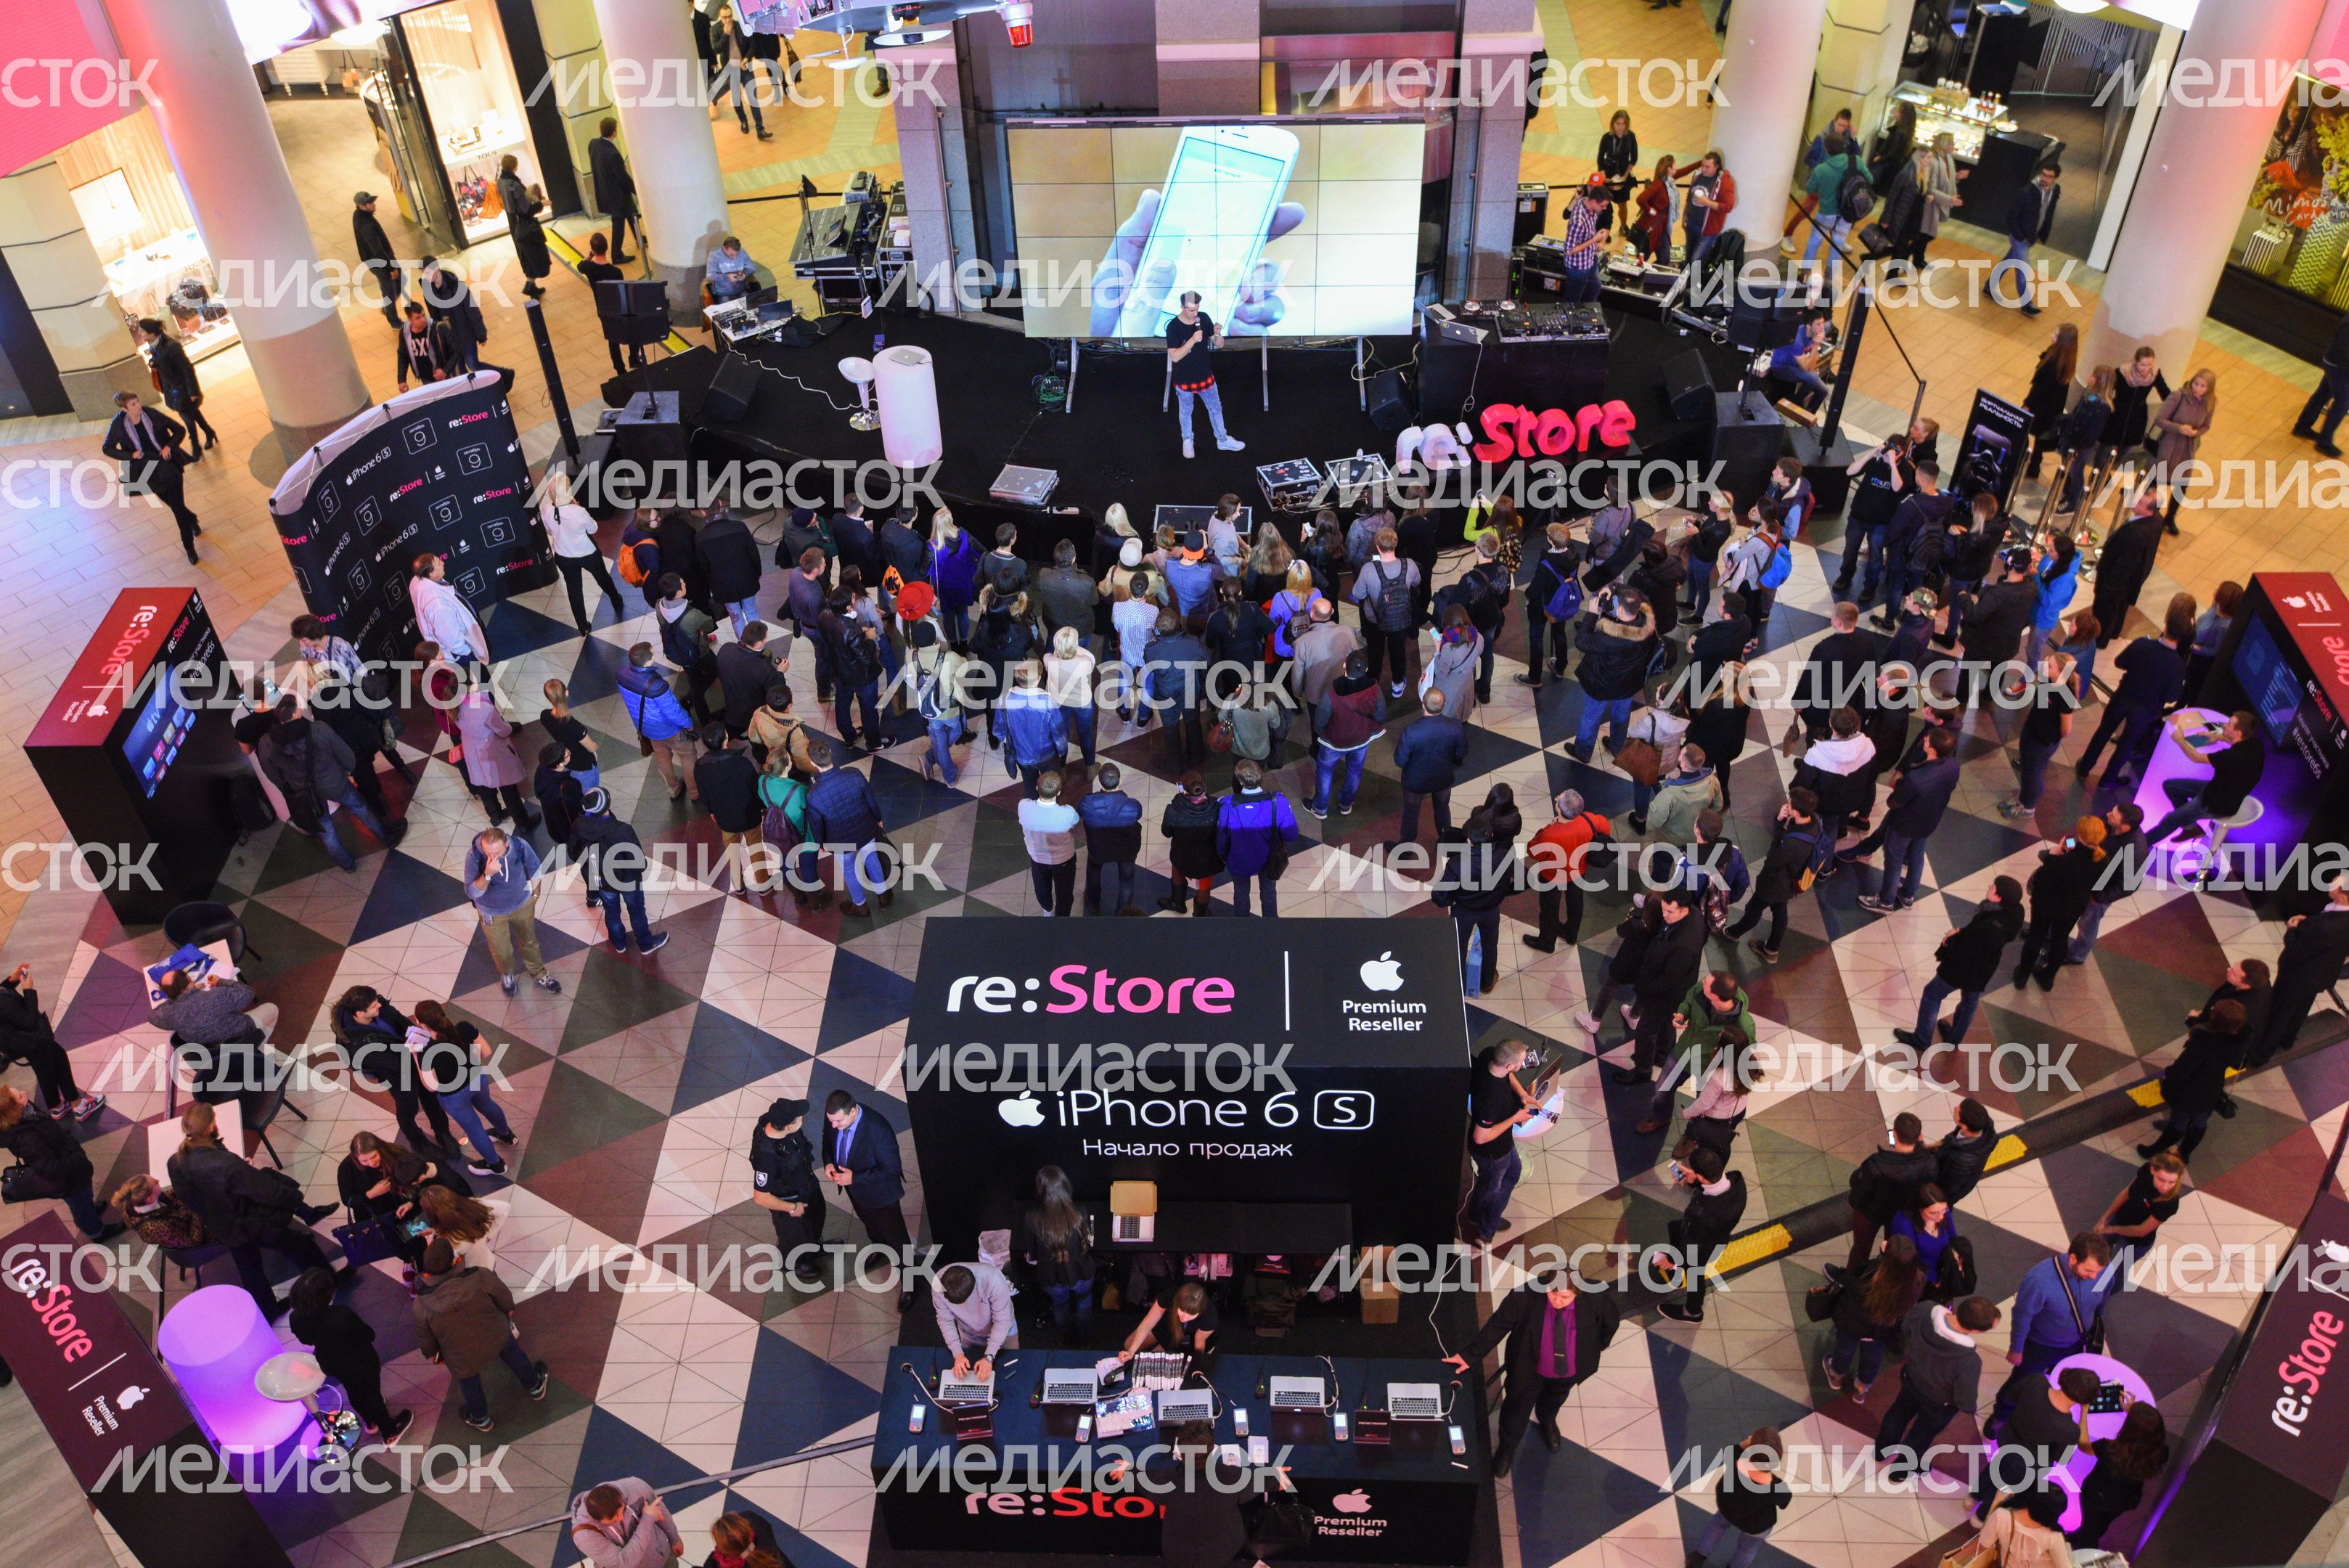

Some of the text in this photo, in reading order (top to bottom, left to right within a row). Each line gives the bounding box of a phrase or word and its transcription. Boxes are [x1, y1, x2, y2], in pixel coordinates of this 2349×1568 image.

[478, 151, 497, 160] TOUS
[449, 411, 489, 429] re:Store
[1396, 400, 1636, 474] re:Store
[351, 460, 376, 481] iPhone
[375, 453, 382, 463] 6
[389, 478, 423, 502] re:Store
[473, 487, 512, 504] re:Store
[380, 536, 403, 558] iPhone
[403, 529, 409, 540] 6
[496, 558, 534, 576] re:Store
[100, 605, 158, 675] re:Store
[168, 616, 189, 653] re:Store
[2307, 679, 2332, 722] re:Store
[947, 964, 1235, 1014] re:Store
[1342, 1000, 1427, 1014] Premium
[1348, 1017, 1423, 1032] Reseller
[1057, 1088, 1247, 1127] iPhone
[1264, 1090, 1299, 1127] 6
[1082, 1139, 1294, 1160] Начало продаж
[11, 1258, 93, 1363] re:Store
[2271, 1310, 2345, 1437] re:Store
[82, 1405, 105, 1437] Reseller
[94, 1395, 119, 1431] Premium
[965, 1487, 1166, 1519] re:Sto
[1314, 1516, 1387, 1528] Premium
[1318, 1527, 1383, 1538] Reseller
